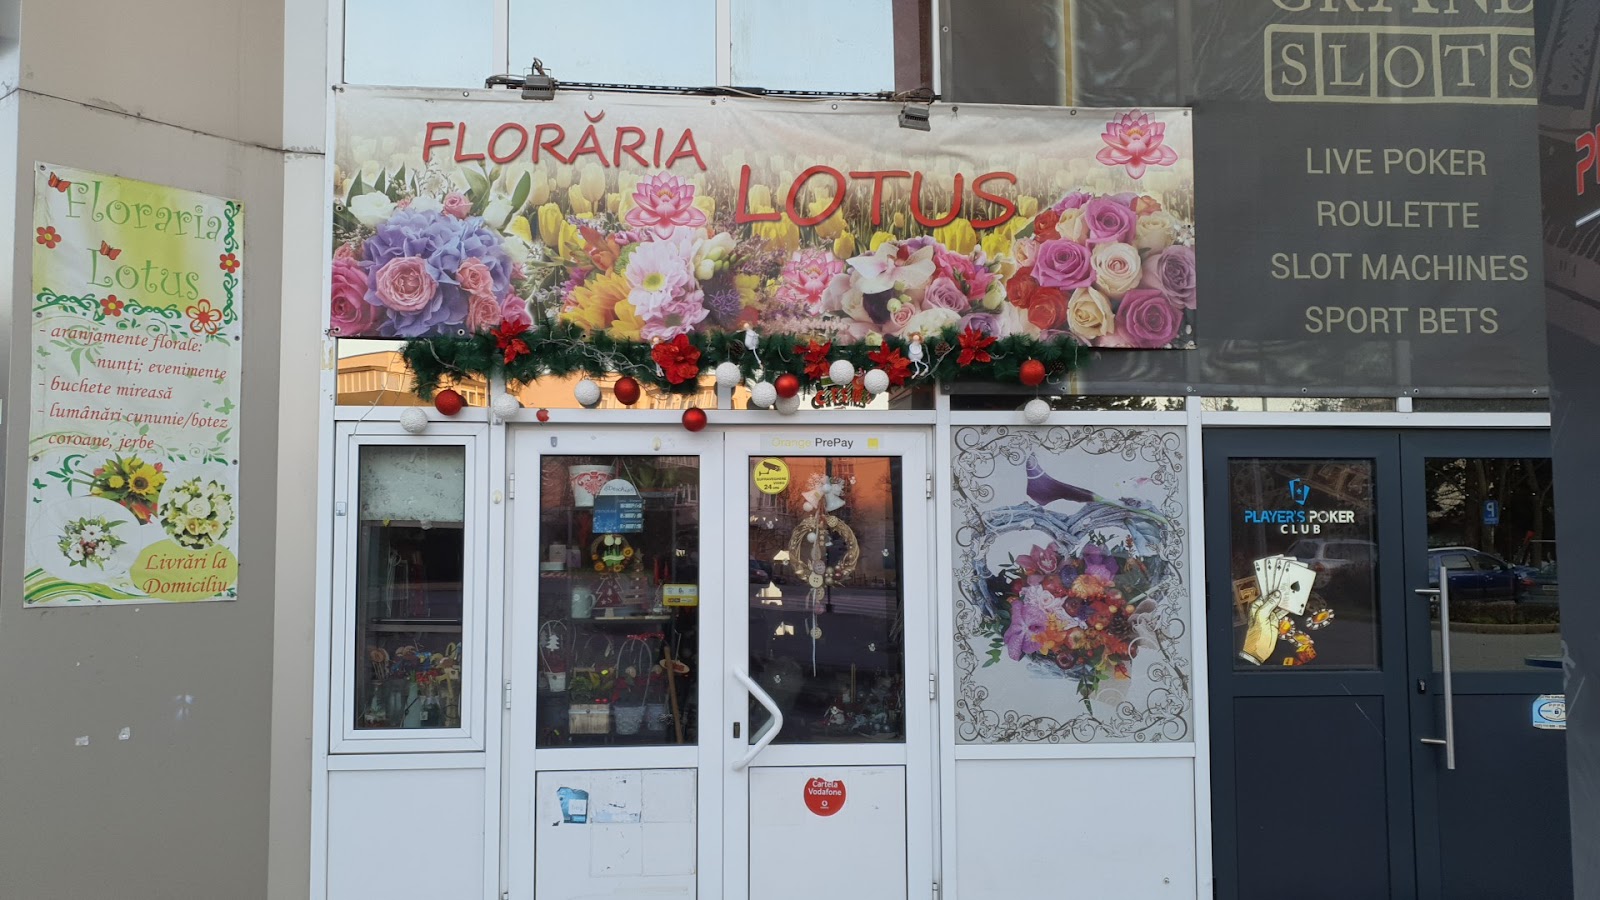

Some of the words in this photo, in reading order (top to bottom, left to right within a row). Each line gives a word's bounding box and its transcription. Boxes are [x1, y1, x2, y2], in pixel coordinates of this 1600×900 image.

[1281, 43, 1535, 89] SLOTS
[422, 109, 708, 171] FLORĂRIA
[1306, 147, 1374, 175] LIVE
[1383, 148, 1488, 176] POKER
[1574, 122, 1600, 196] P
[735, 164, 1017, 229] LOTUS
[66, 180, 223, 242] Floraria
[1317, 200, 1480, 228] ROULETTE
[87, 247, 200, 300] Lotus
[1271, 252, 1353, 280] SLOT
[1361, 254, 1530, 282] MACHINES
[1304, 305, 1409, 334] SPORT
[1419, 307, 1499, 334] BETS
[51, 326, 149, 349] aranjamente
[149, 333, 203, 353] florale:
[148, 362, 228, 380] evenimente
[50, 376, 112, 396] buchete
[116, 384, 174, 400] mireasă
[49, 402, 122, 421] lumânări
[125, 411, 229, 429] cununie/botez
[48, 433, 113, 449] coroane,
[117, 435, 155, 452] jerbe
[771, 437, 812, 449] Orange
[815, 437, 854, 449] PrePay
[1244, 510, 1306, 523] PLAYER'S
[1309, 510, 1355, 523] POKER
[1280, 524, 1321, 534] CLUB
[145, 552, 207, 571] Livrări
[211, 551, 228, 570] la
[142, 575, 228, 594] Domiciliu
[807, 787, 842, 796] Vodafone
[812, 780, 839, 788] Cartela
